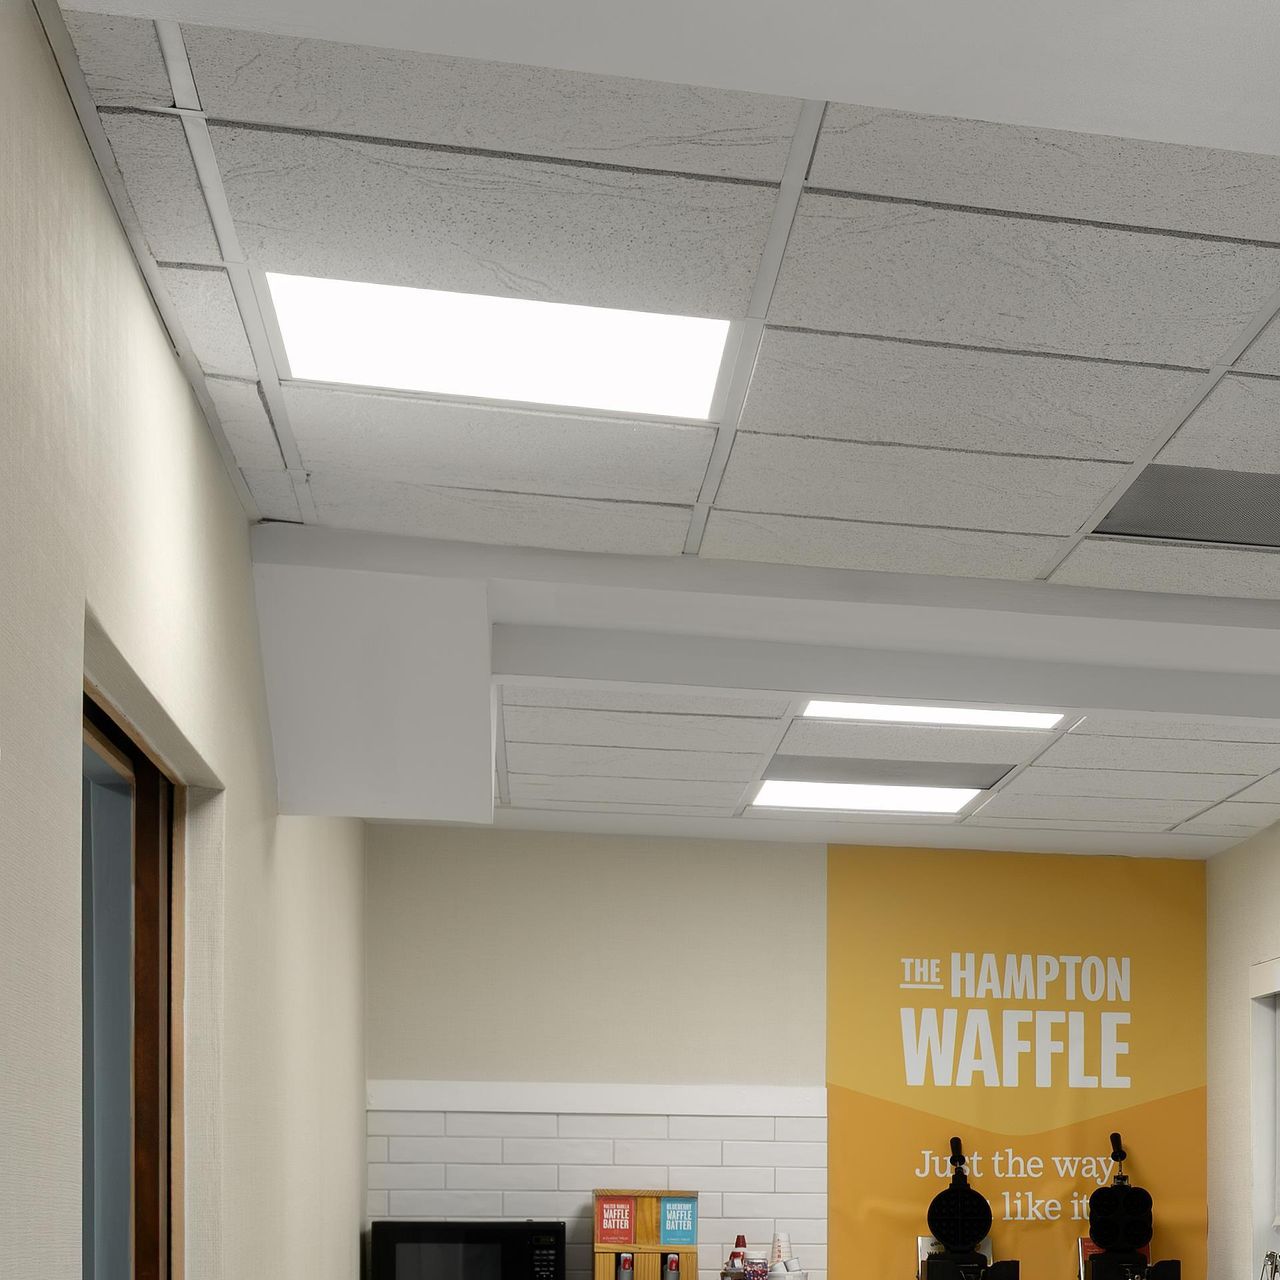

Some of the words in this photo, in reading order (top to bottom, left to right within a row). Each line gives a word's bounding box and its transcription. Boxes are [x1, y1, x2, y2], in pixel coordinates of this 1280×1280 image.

[901, 958, 941, 983] THE
[951, 952, 1131, 1002] HAMPTON
[900, 1007, 1131, 1089] WAFFLE
[992, 1148, 1044, 1178] the
[1051, 1156, 1116, 1185] way
[603, 1209, 630, 1220] WAFFLE
[666, 1210, 692, 1220] WAFFLE
[1001, 1191, 1062, 1221] like
[602, 1219, 629, 1229] BATTER
[666, 1220, 692, 1231] BATTER
